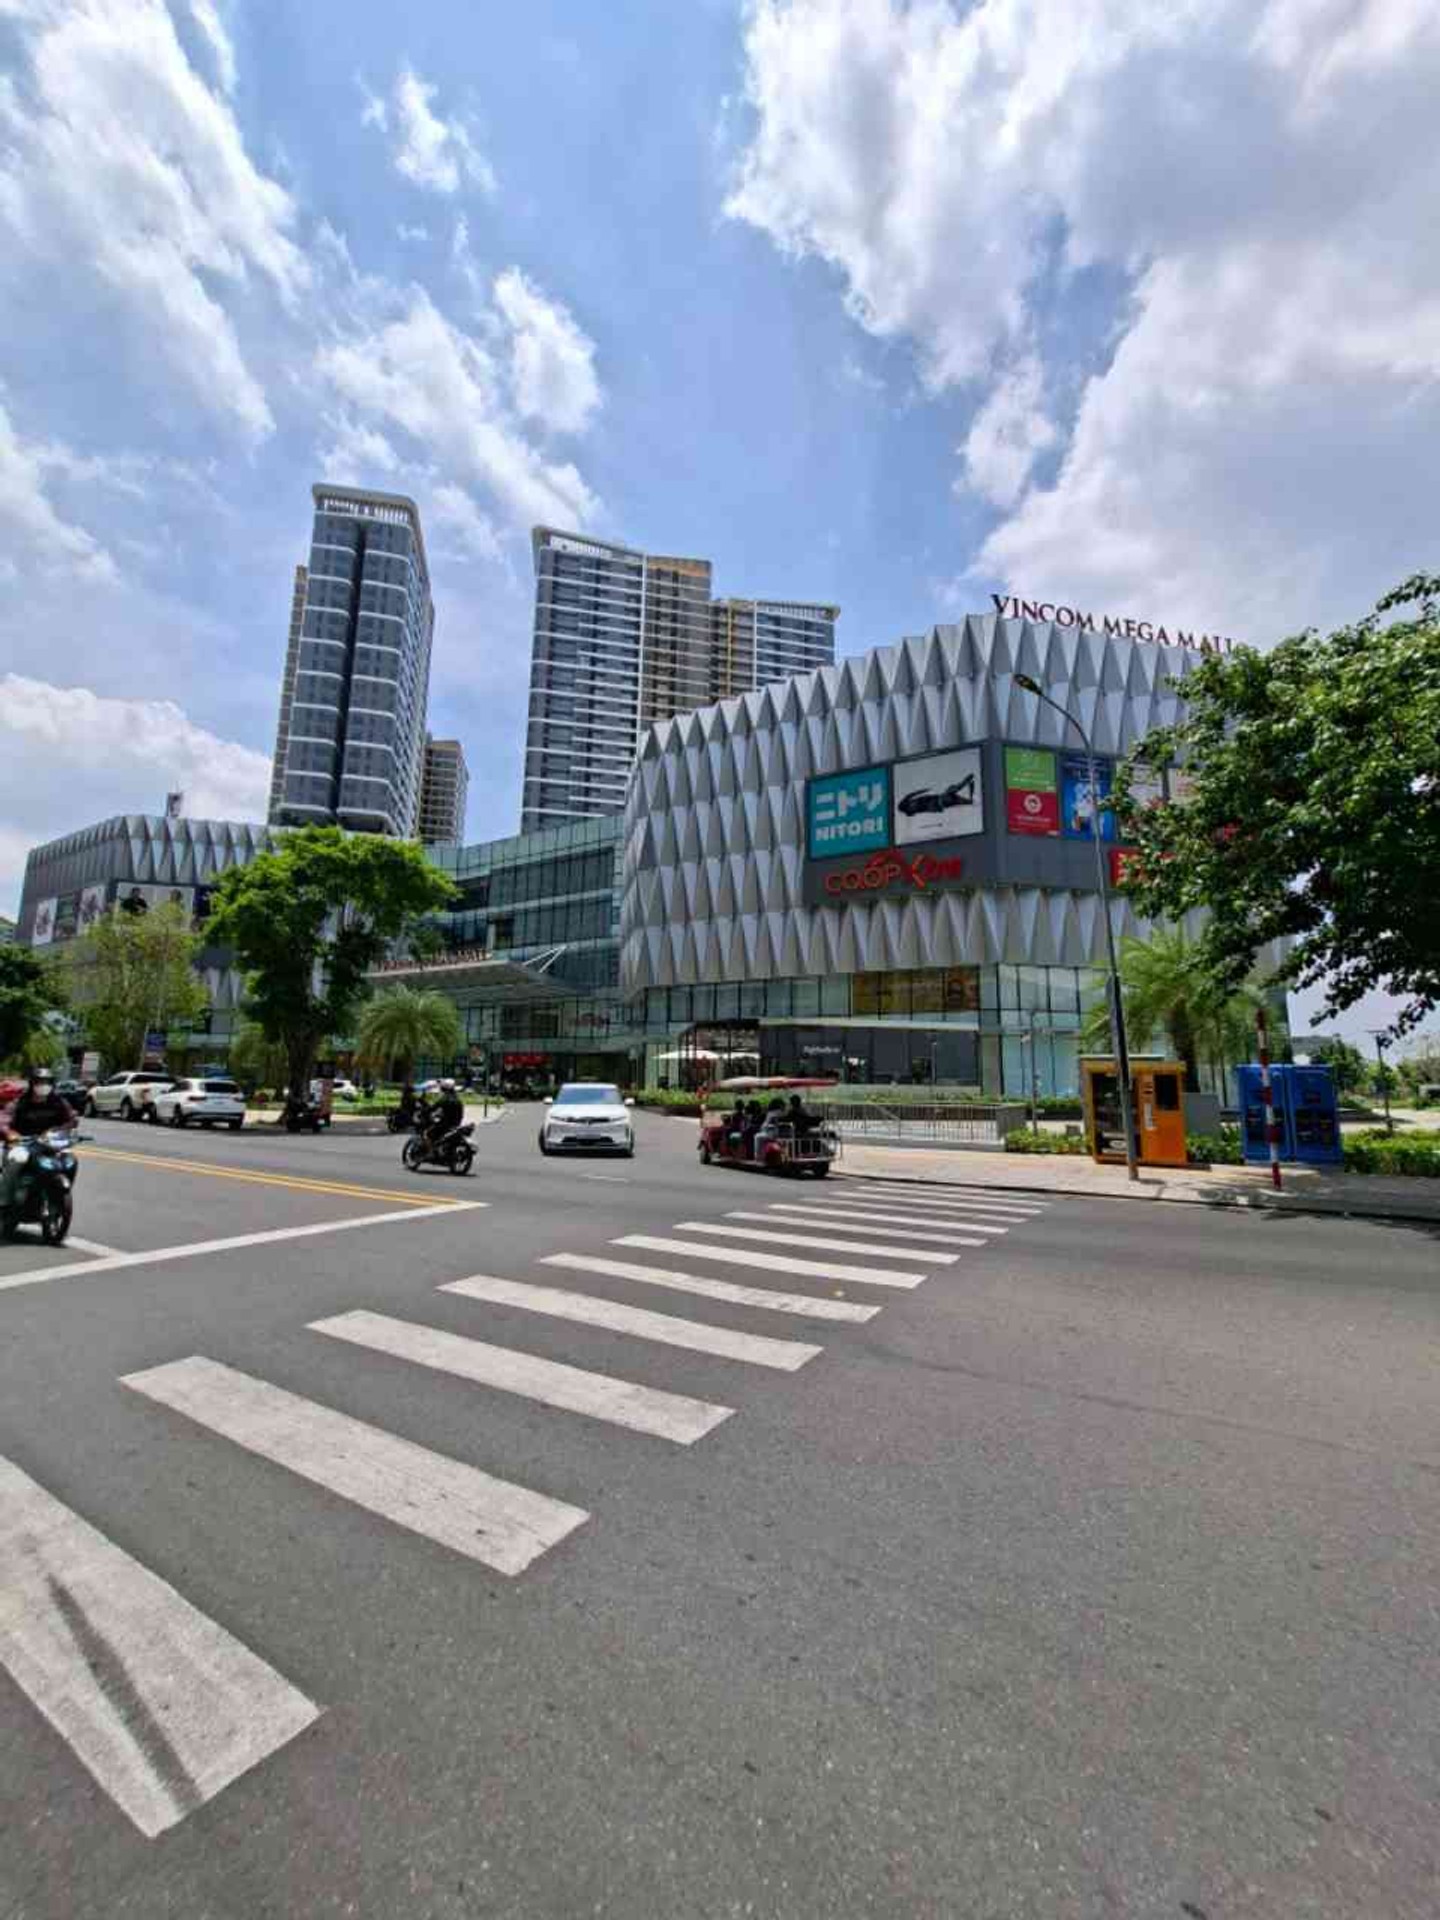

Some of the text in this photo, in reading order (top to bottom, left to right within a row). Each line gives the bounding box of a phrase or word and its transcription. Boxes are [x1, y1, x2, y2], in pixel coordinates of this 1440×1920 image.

[991, 594, 1094, 632] VINCOM
[1103, 615, 1169, 645] MEGA
[816, 783, 883, 821] ニトリ
[816, 816, 883, 841] NITORI
